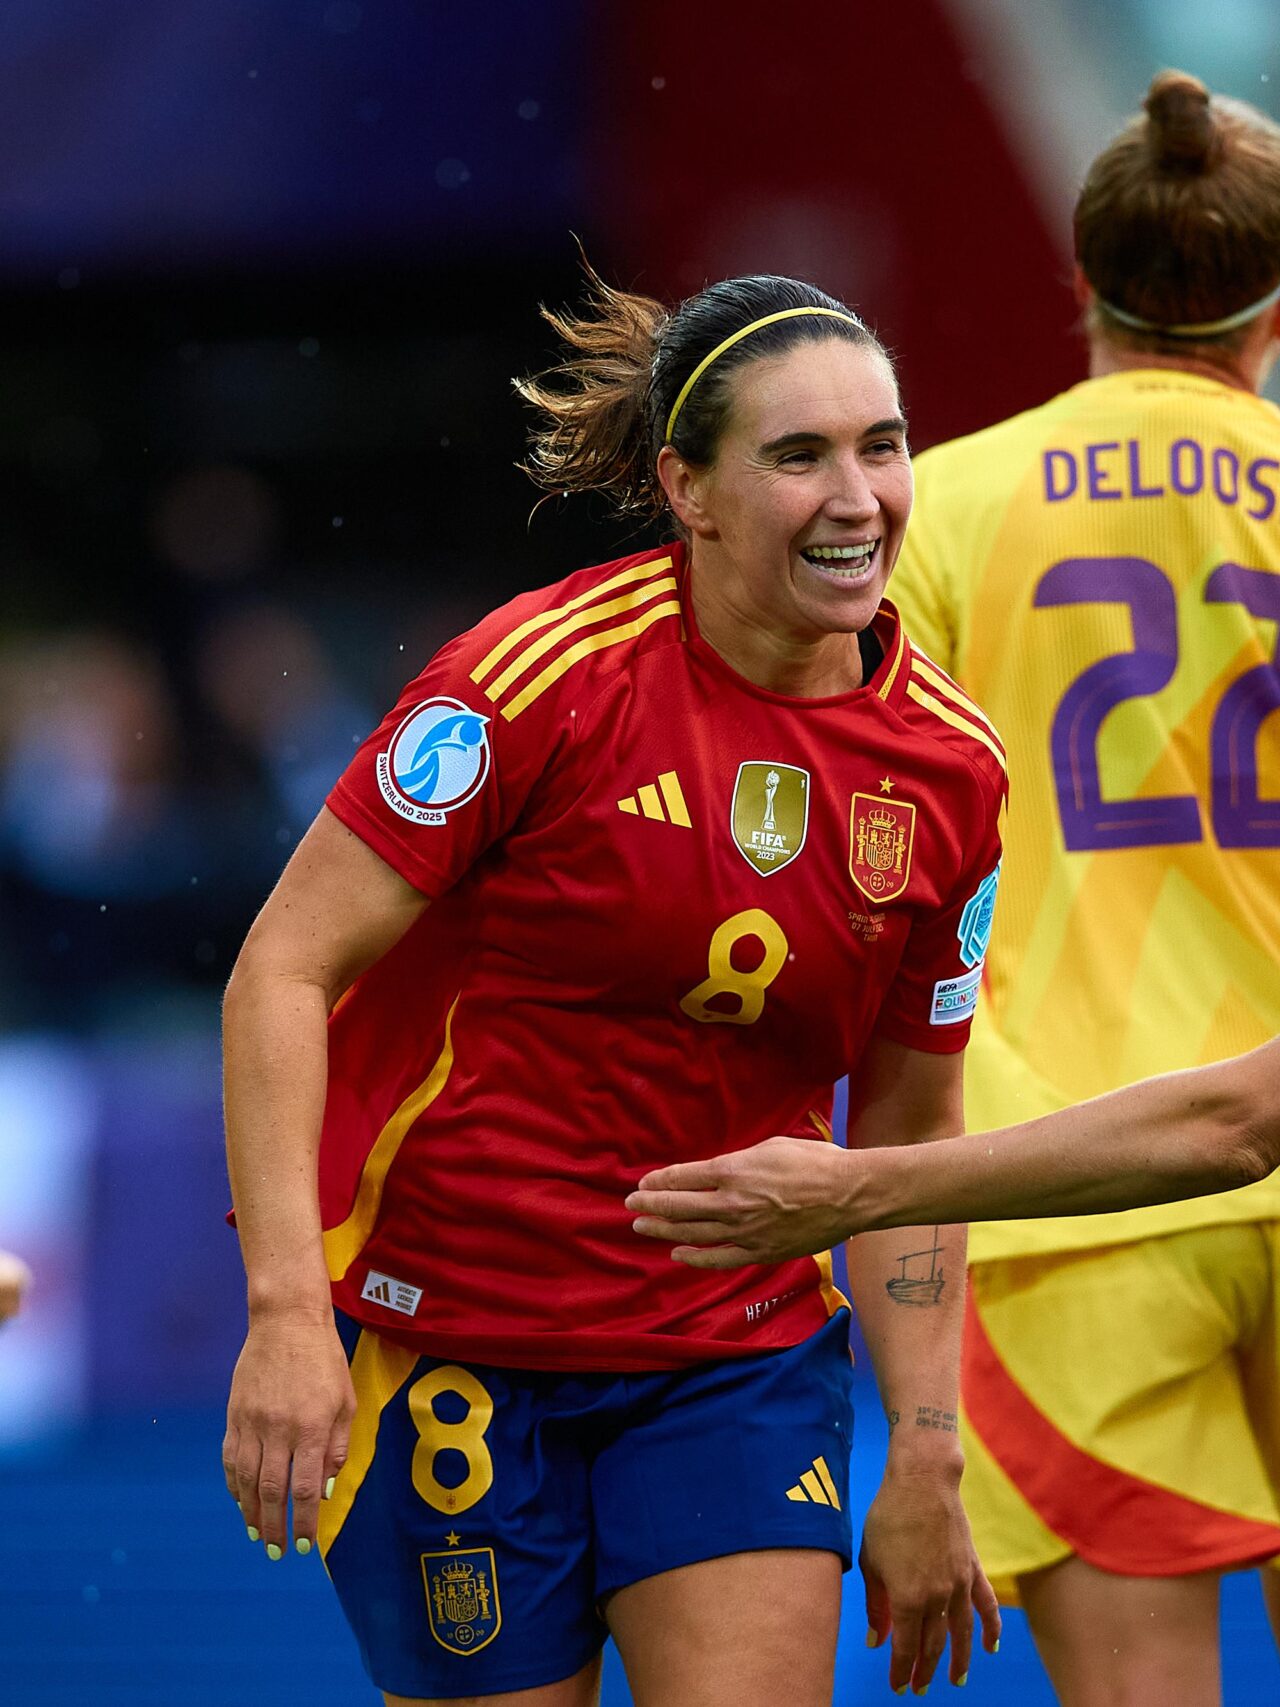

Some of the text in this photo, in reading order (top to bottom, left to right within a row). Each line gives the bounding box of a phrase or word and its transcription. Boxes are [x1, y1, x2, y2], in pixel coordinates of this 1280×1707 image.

[379, 756, 443, 821] SWITZERLAND 2025
[751, 830, 785, 848] FIFA
[756, 850, 775, 861] 2023
[679, 908, 789, 1025] 8
[407, 1364, 494, 1516] 8
